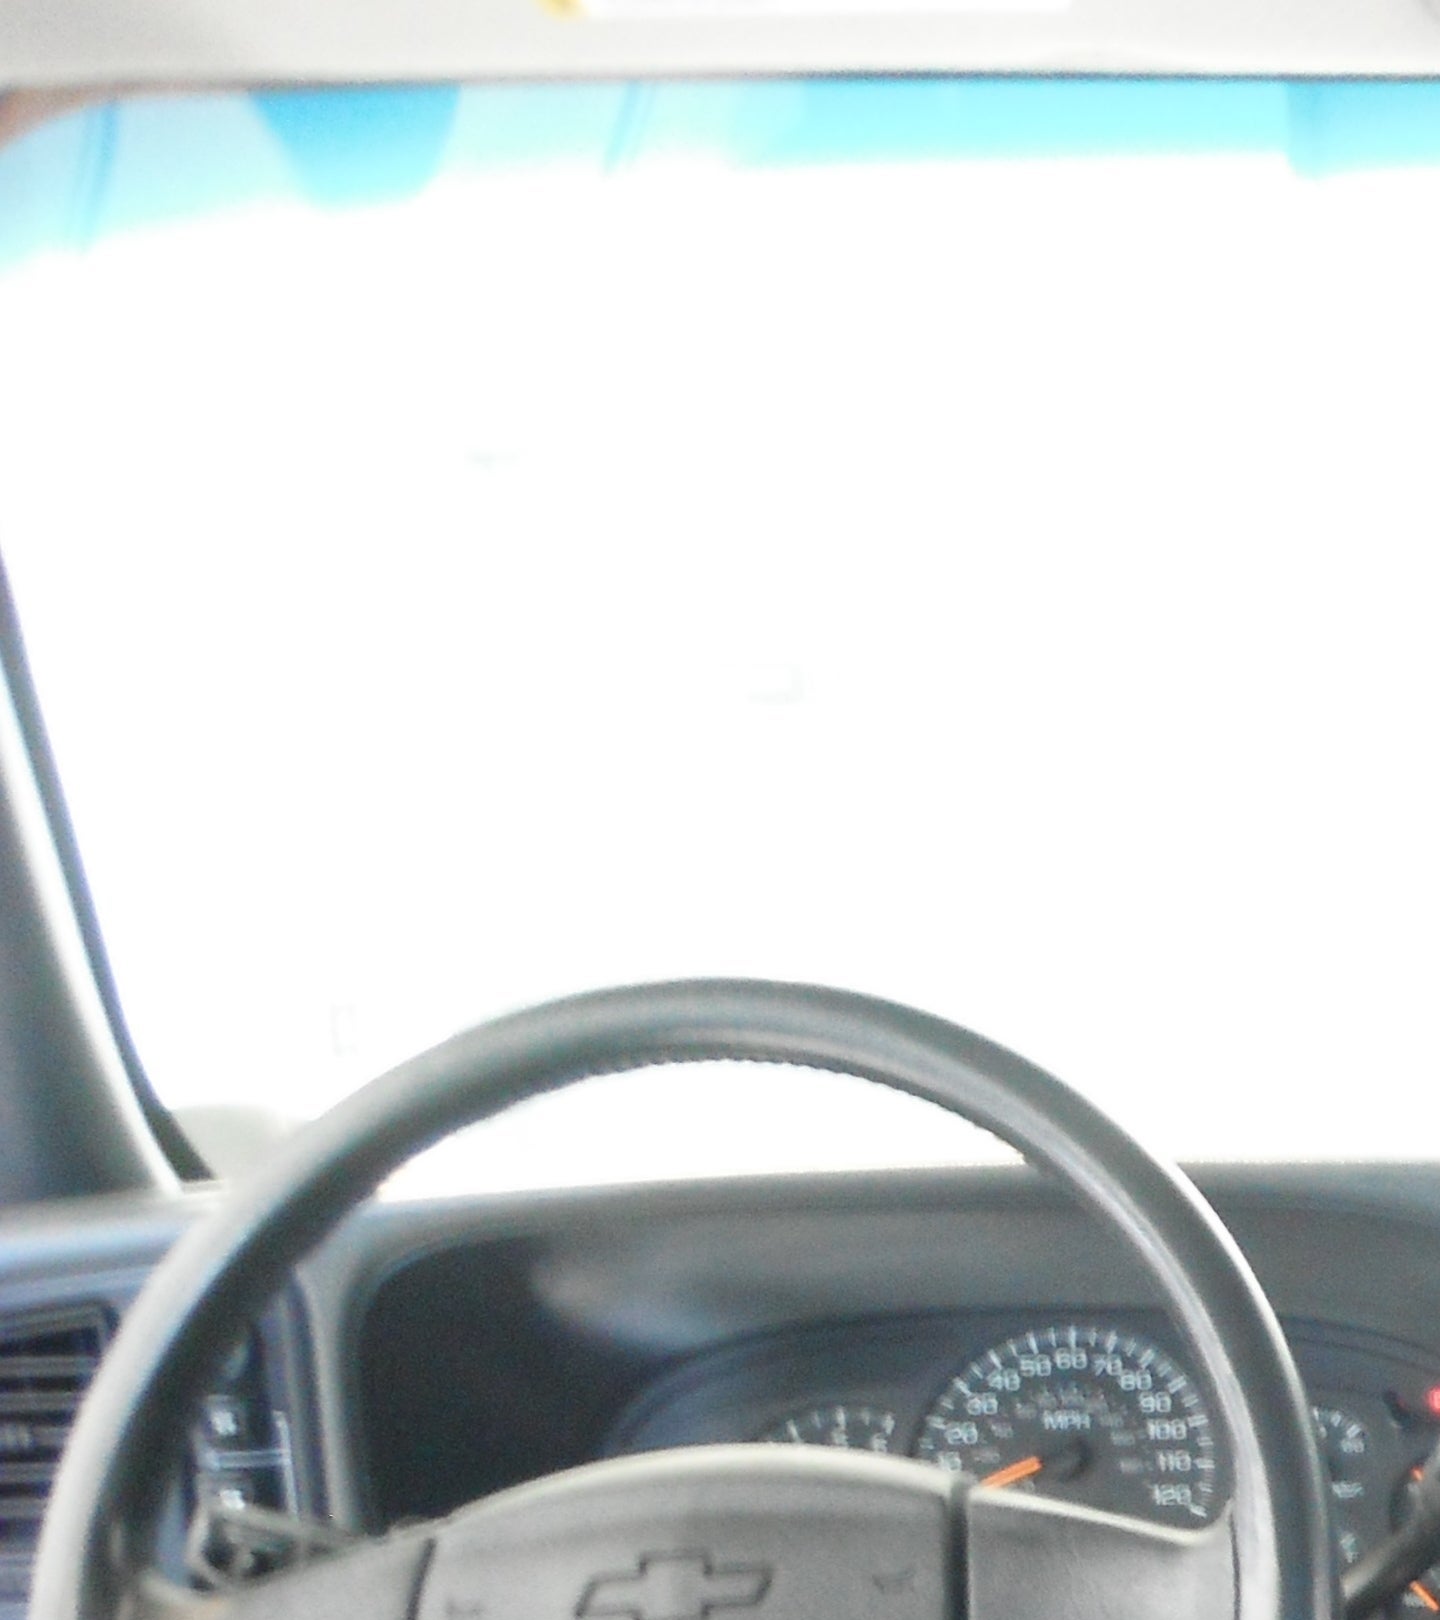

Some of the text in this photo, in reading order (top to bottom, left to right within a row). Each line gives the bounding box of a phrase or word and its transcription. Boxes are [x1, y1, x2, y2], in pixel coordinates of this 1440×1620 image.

[1019, 1354, 1051, 1377] 50
[1055, 1348, 1088, 1370] 60
[1093, 1356, 1122, 1377] 70
[987, 1368, 1020, 1391] 40
[1118, 1367, 1152, 1391] 80
[1139, 1391, 1172, 1413] 90
[1043, 1410, 1091, 1430] MPH
[1148, 1418, 1187, 1440] 100
[946, 1421, 978, 1445] 20
[1159, 1450, 1192, 1471] 110
[1154, 1484, 1192, 1506] 120
